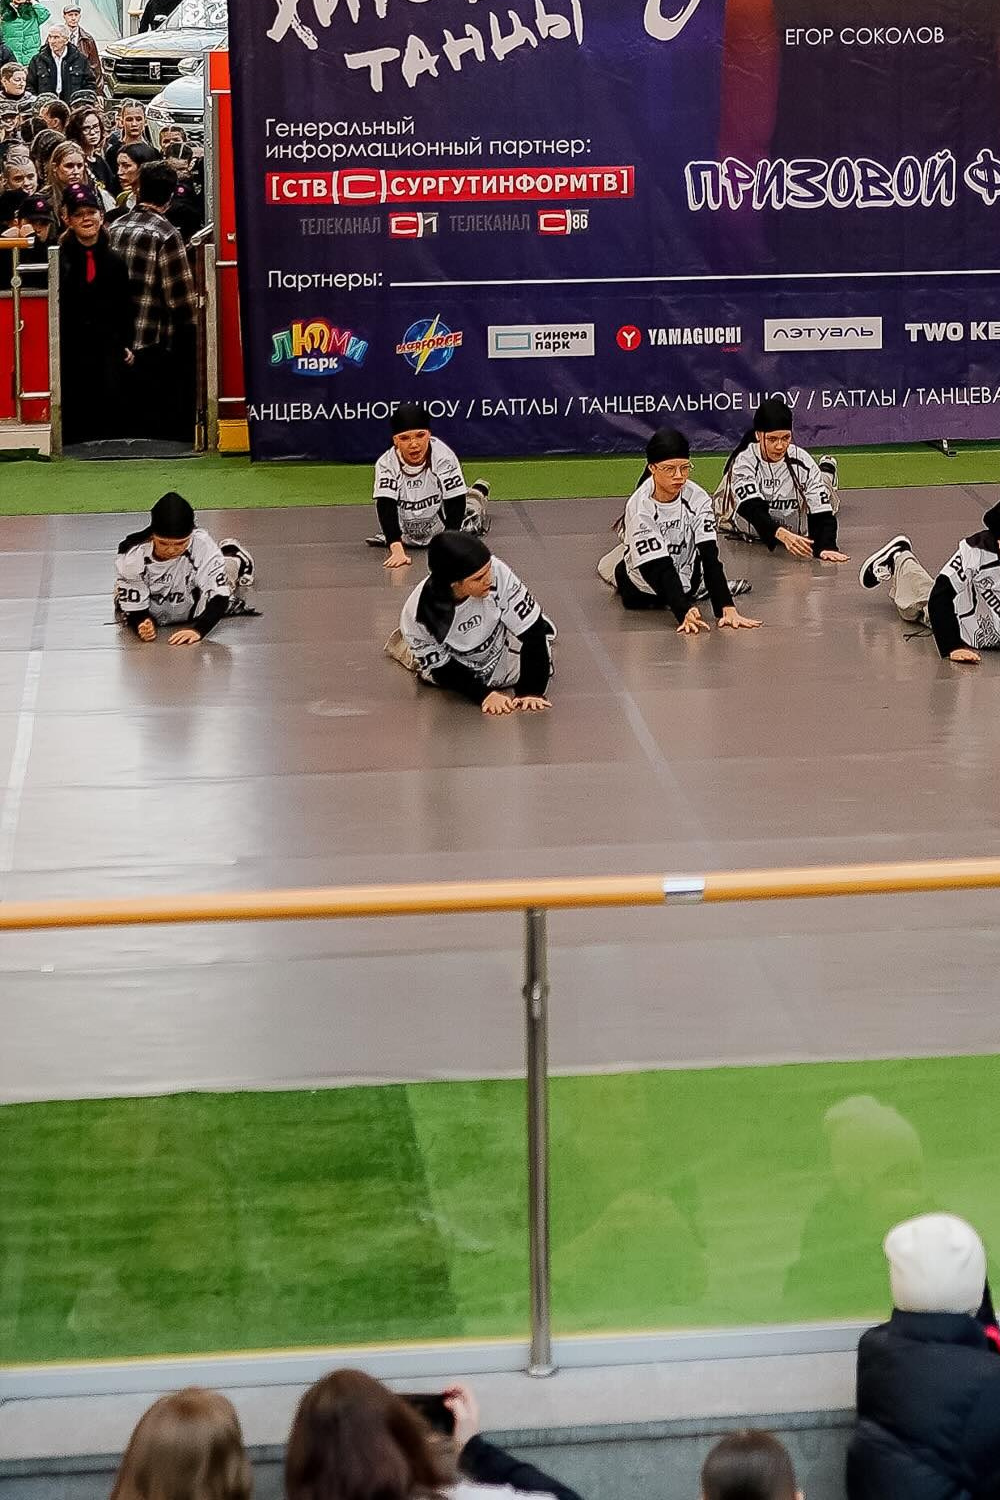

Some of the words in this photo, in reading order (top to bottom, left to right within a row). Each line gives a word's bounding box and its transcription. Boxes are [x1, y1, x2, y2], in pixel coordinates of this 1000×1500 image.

[786, 28, 833, 45] ЕГОР
[840, 27, 944, 44] СОКОЛОВ
[265, 116, 415, 139] Генеральный
[265, 136, 482, 160] информационный
[490, 139, 590, 158] партнер:
[684, 149, 956, 210] ПРИЗОВОЙ
[301, 217, 381, 235] ТЕЛЕКАНАЛ
[450, 215, 531, 232] ТЕЛЕКАНАЛ
[269, 271, 382, 291] Партнеры:
[535, 329, 587, 342] синема
[648, 327, 741, 345] YAMAGUCHI
[905, 323, 963, 341] TWO
[535, 341, 570, 353] парк
[298, 358, 337, 372] парк
[247, 401, 400, 422] АНЦЕВАЛЬНОЕ
[482, 398, 557, 416] БАТТЛЫ
[579, 393, 742, 414] ТАНЦЕВАЛЬНОЕ
[822, 389, 895, 407] БАТТЛЫ
[380, 478, 398, 491] 20
[443, 475, 463, 491] 22
[735, 484, 757, 500] 20
[636, 537, 662, 556] 20
[118, 588, 140, 602] 20
